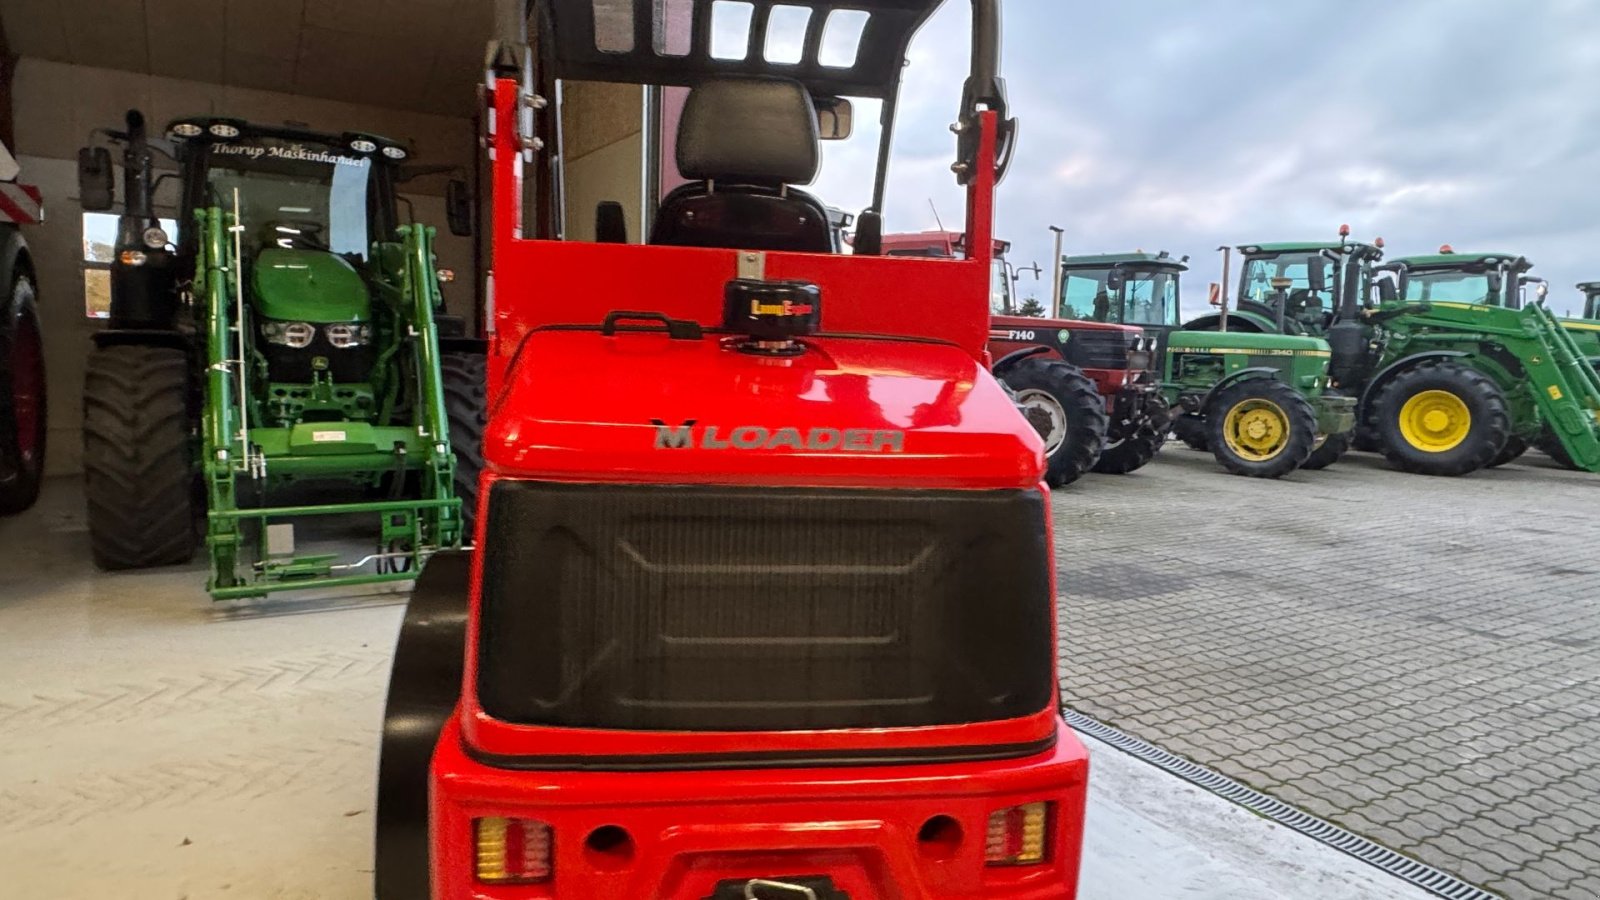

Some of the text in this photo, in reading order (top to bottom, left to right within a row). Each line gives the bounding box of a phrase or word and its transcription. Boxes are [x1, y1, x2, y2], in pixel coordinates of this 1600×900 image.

[211, 142, 365, 168] Thorup Maskinhandel
[1008, 329, 1035, 340] F140
[702, 425, 905, 451] LOADER
